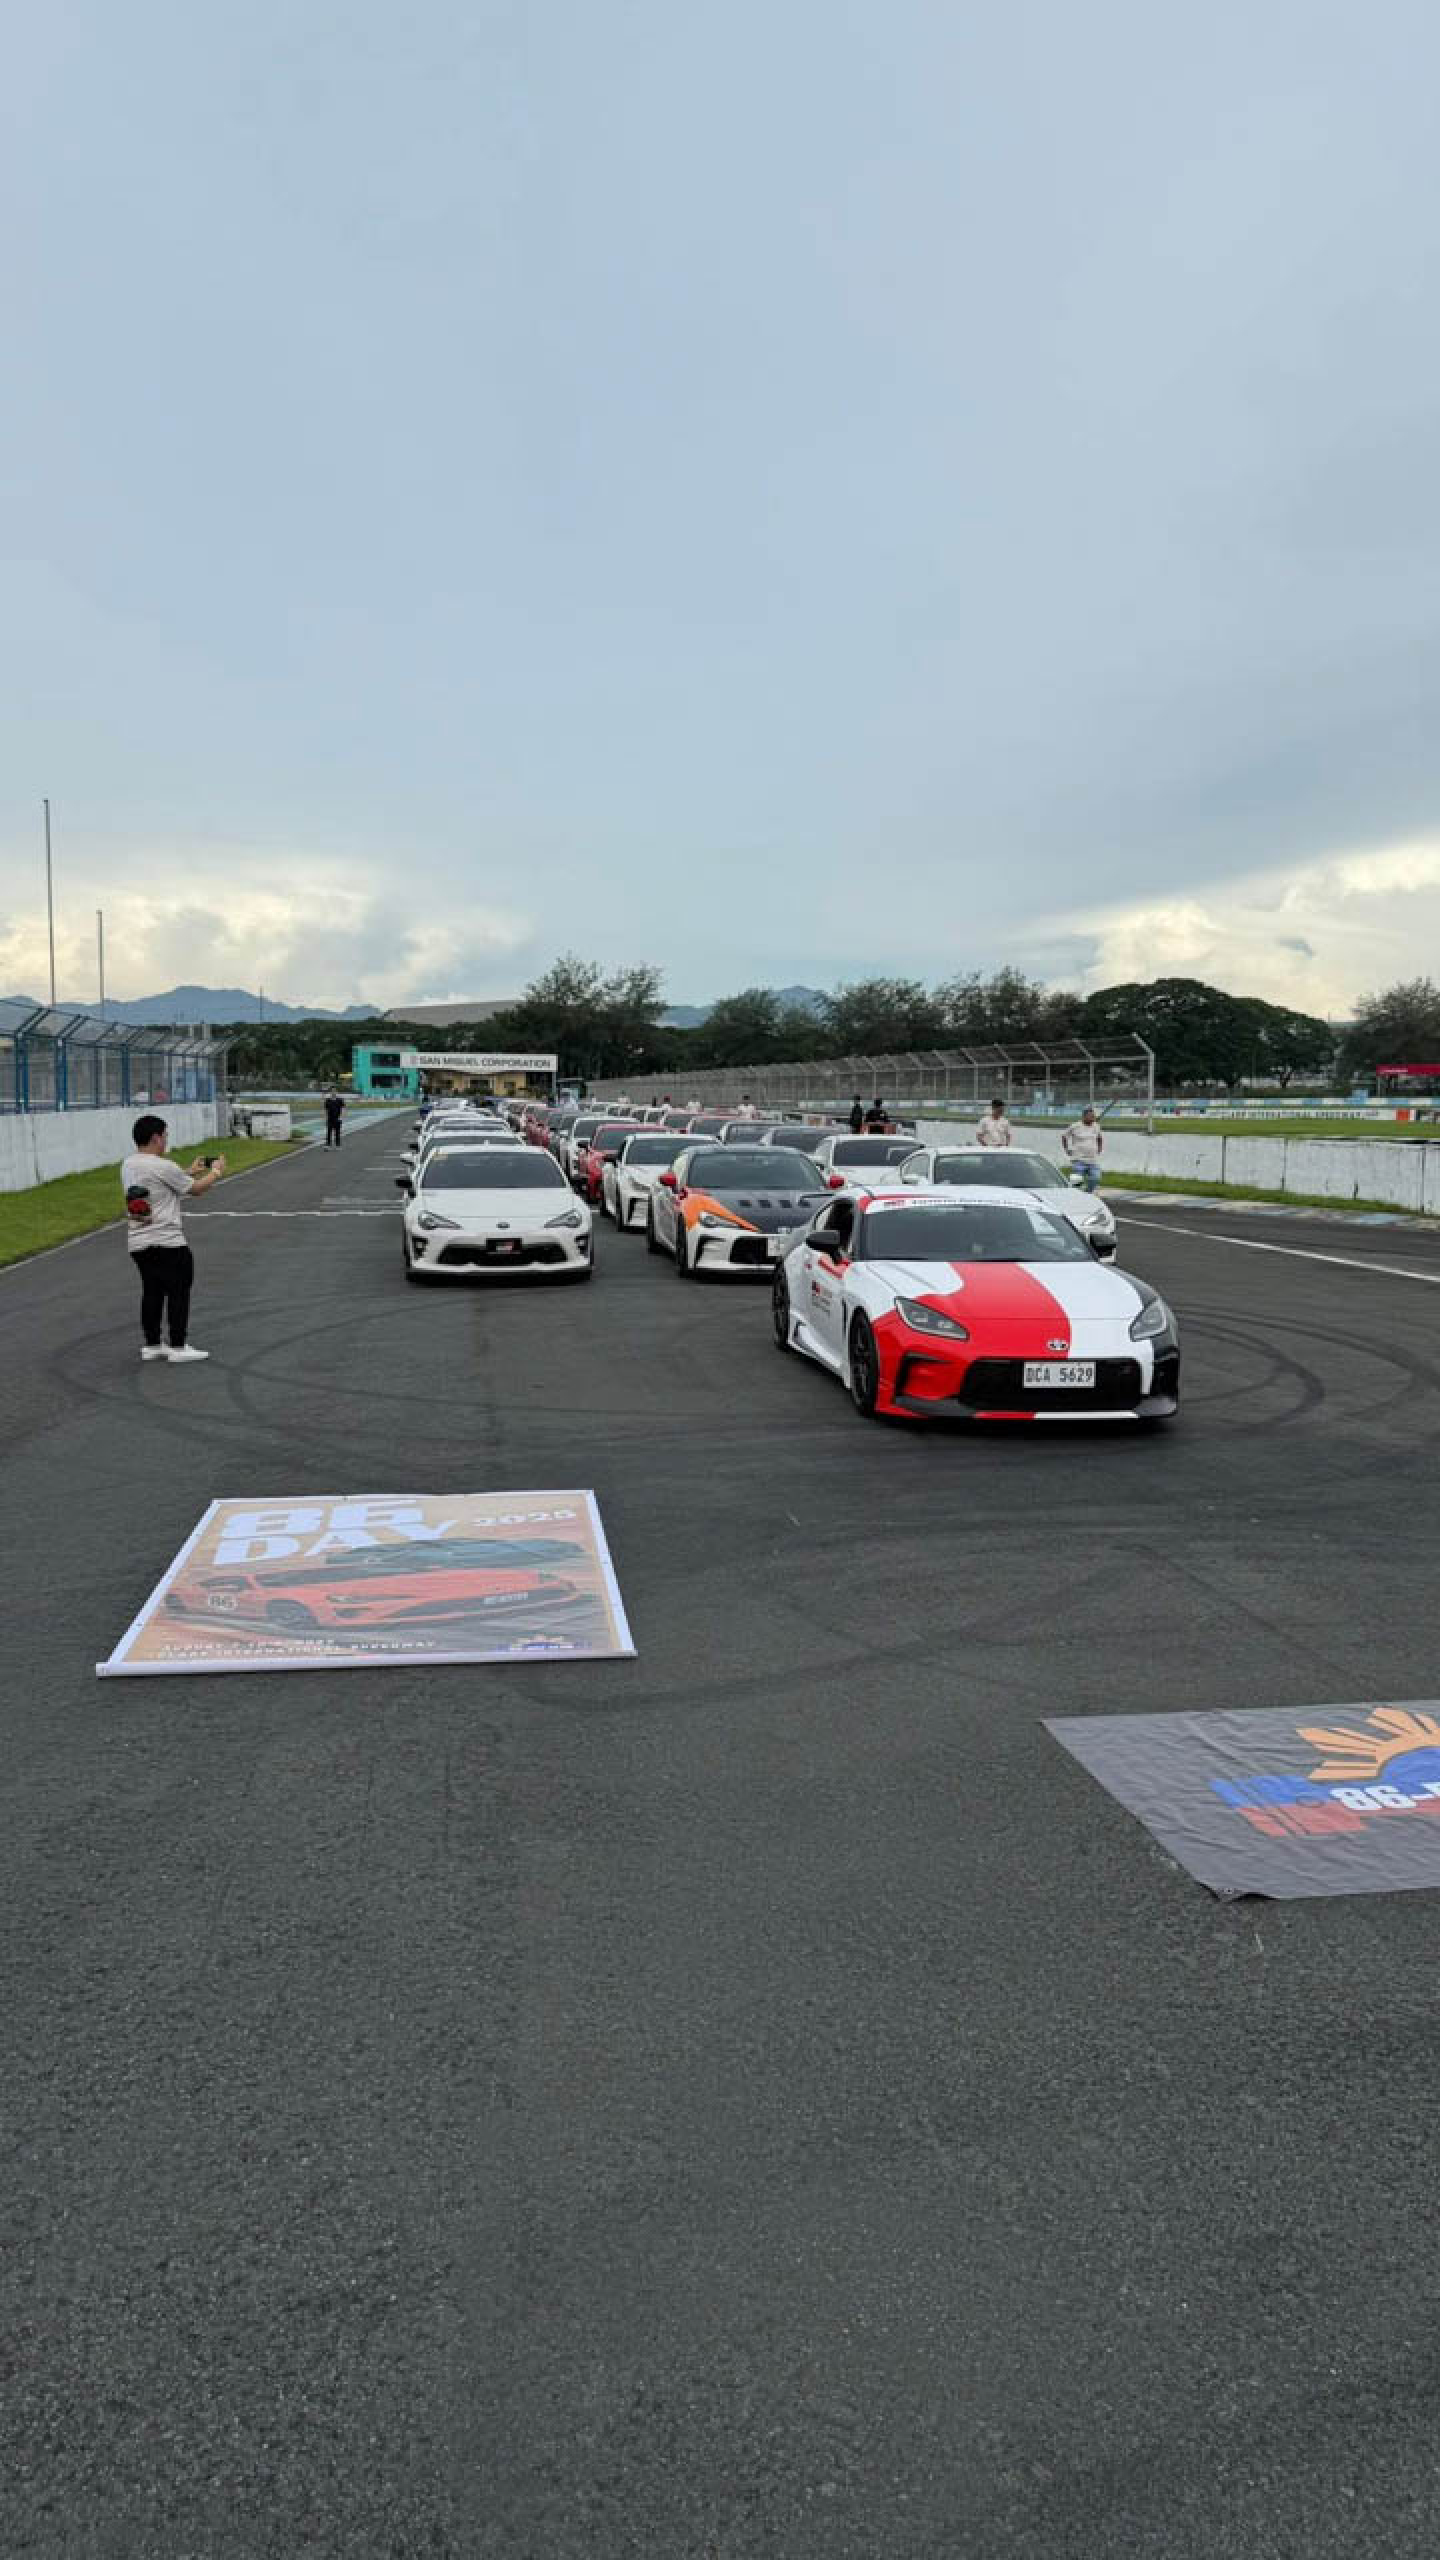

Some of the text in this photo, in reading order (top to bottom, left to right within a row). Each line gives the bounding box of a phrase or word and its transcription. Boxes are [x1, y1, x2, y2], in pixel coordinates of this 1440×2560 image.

[419, 1055, 552, 1068] SAN MIGUEL CORPORATION
[1026, 1367, 1093, 1383] DCA 5629
[219, 1499, 427, 1539] 86
[213, 1519, 460, 1565] DAY
